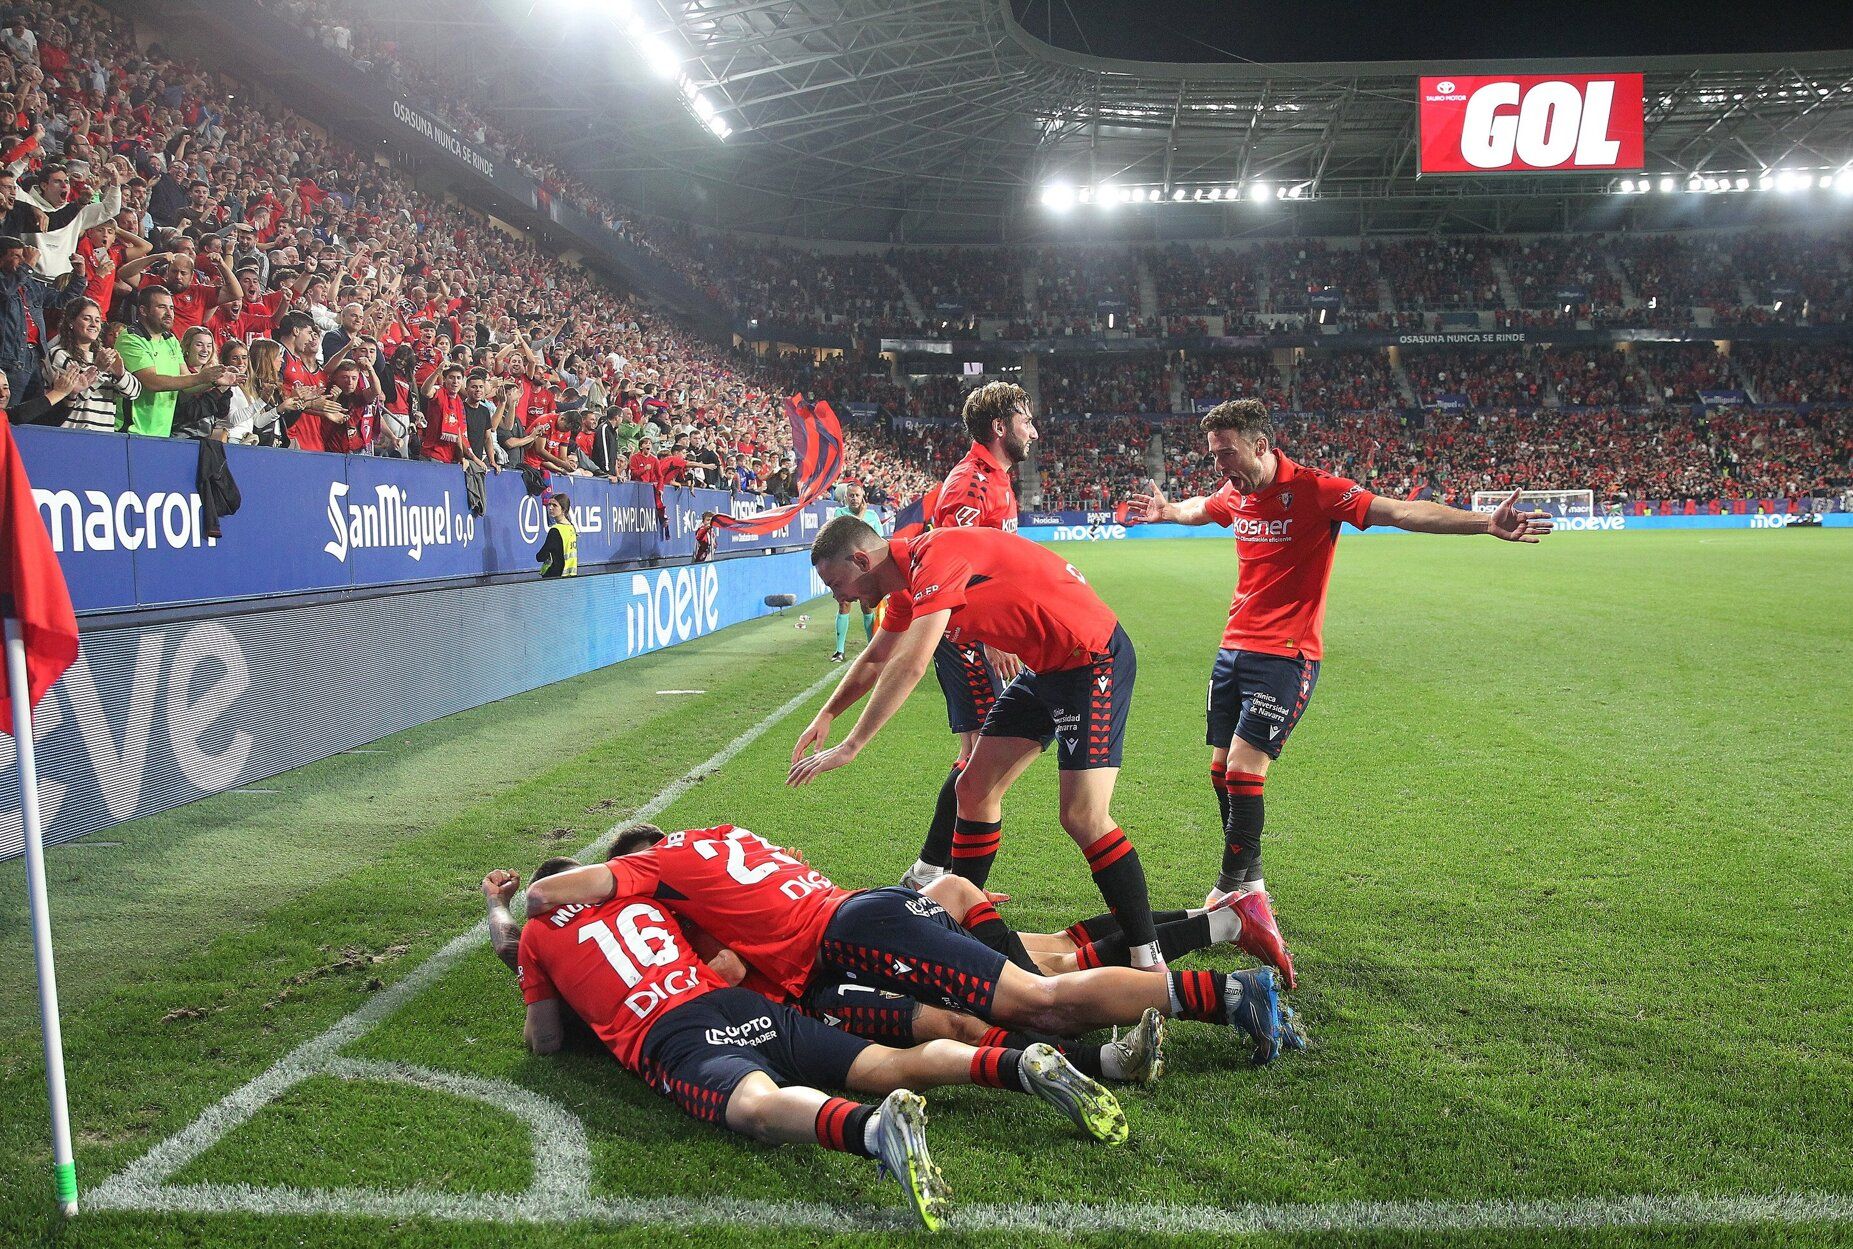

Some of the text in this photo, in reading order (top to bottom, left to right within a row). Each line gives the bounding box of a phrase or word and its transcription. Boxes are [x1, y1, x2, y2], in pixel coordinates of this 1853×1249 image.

[393, 100, 494, 178] OSASUNA NUNCA SE RINDE
[1460, 80, 1621, 168] GOL
[1400, 333, 1525, 344] OSASUNA NUNCA SE RINDE
[324, 481, 451, 563] SanMiguel
[542, 505, 601, 533] LXUS
[612, 506, 658, 533] PAMPLONA
[1054, 525, 1126, 541] moeve
[627, 563, 719, 656] moeve
[1252, 697, 1289, 716] Universidad
[1258, 707, 1285, 722] Navarra
[578, 903, 680, 989] 16
[624, 966, 700, 1019] DIGI
